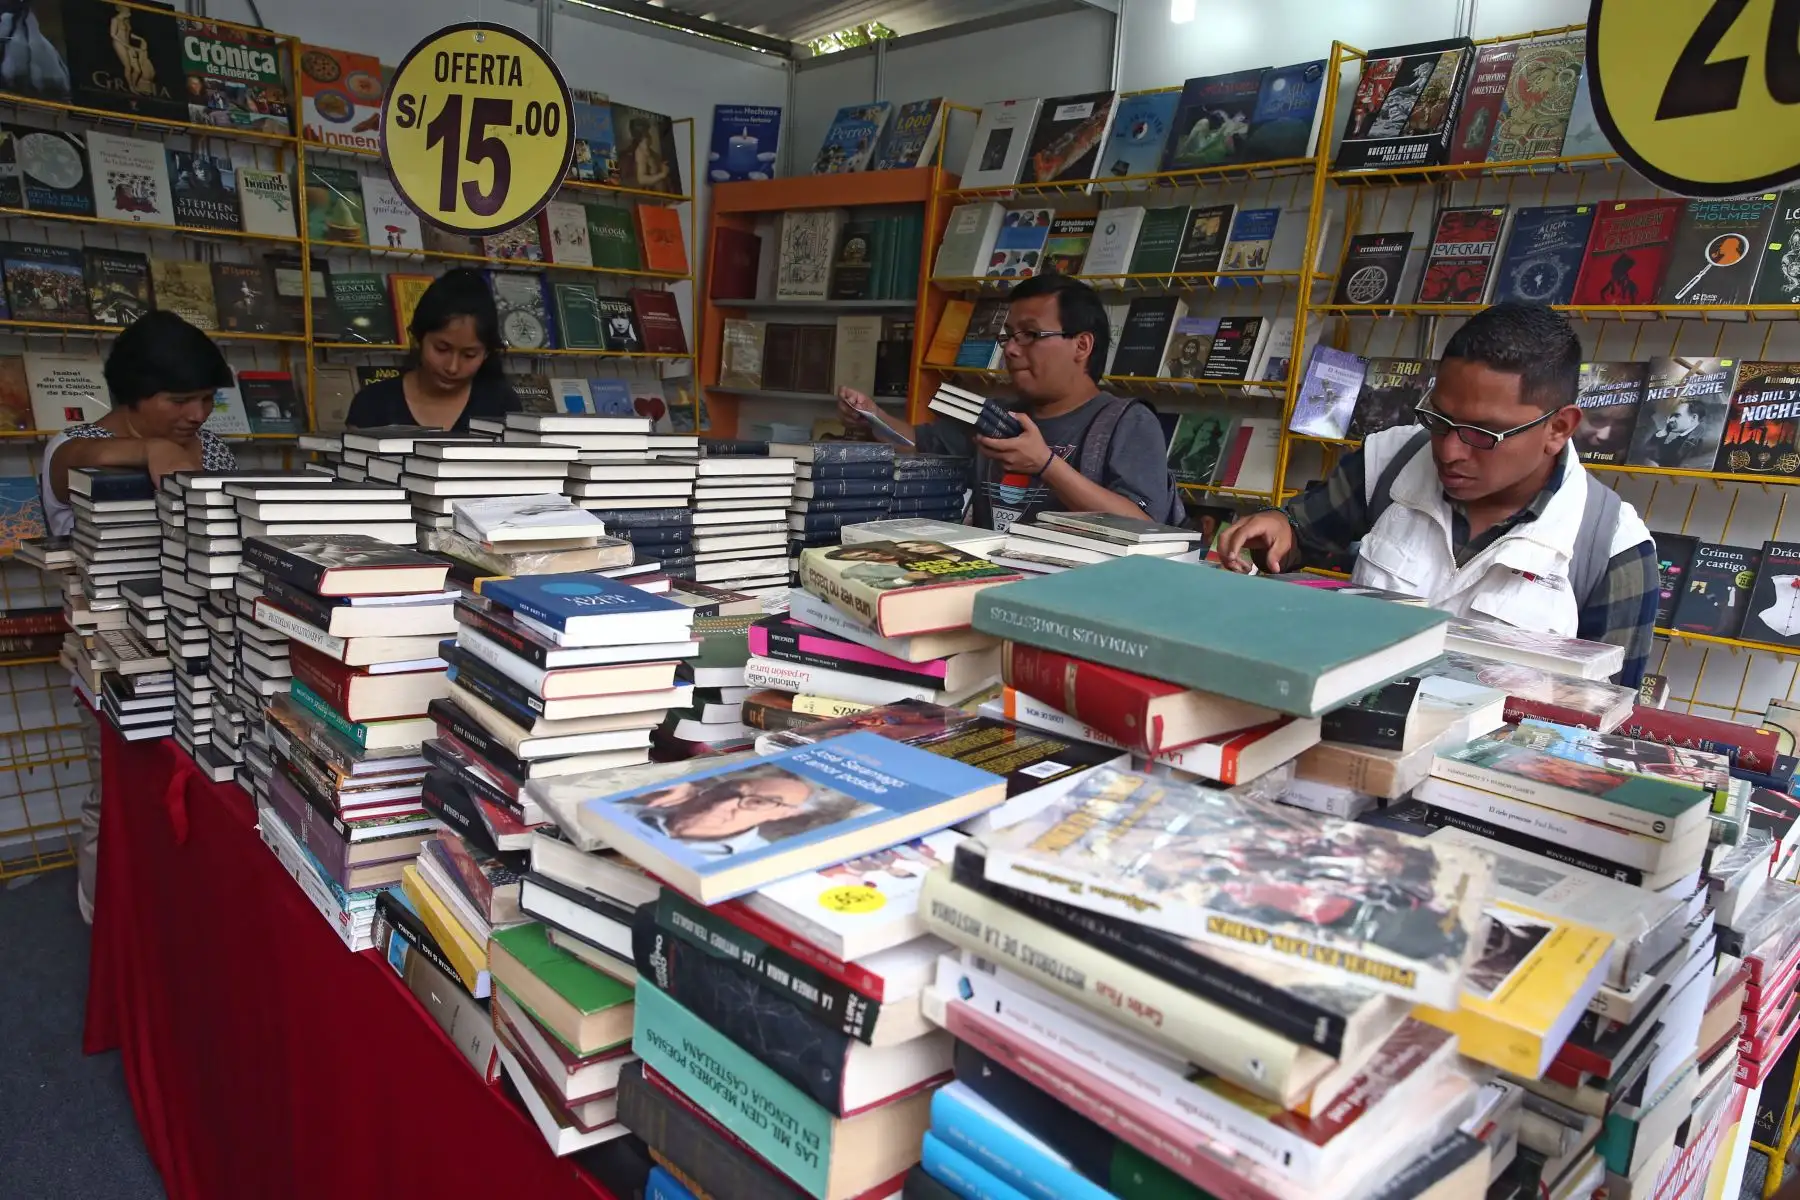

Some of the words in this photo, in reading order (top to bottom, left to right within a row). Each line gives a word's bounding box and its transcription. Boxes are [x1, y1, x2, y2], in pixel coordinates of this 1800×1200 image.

[184, 36, 276, 75] Crónica
[207, 64, 219, 76] de
[220, 67, 259, 82] América
[435, 51, 523, 86] OFERTA
[92, 70, 172, 99] GRIA
[830, 124, 873, 142] Perros
[1367, 146, 1397, 156] NUESTRA
[1399, 143, 1429, 154] MEMORIA
[244, 177, 288, 191] hombre
[179, 198, 233, 212] STEPHEN
[1688, 202, 1773, 212] SHERLOCK
[1723, 194, 1763, 202] COMPLETA
[177, 207, 239, 222] HAWKING
[1695, 212, 1761, 221] HOLMES
[1537, 221, 1567, 236] ALICIA
[1433, 242, 1493, 257] LOVECRAFT
[600, 302, 633, 313] brujas
[1646, 381, 1724, 402] NIETZSCHE
[1737, 394, 1759, 405] Las
[1593, 452, 1614, 461] Freud
[1700, 547, 1744, 560] Crimen
[1695, 558, 1701, 568] y
[1706, 560, 1747, 573] castigo
[838, 586, 855, 608] vez
[854, 594, 871, 617] una
[990, 607, 1071, 640] DOMÉSTICOS
[1072, 626, 1148, 658] ANIMALES
[749, 673, 768, 685] Gala
[768, 677, 801, 690] Antonio
[772, 667, 799, 682] pasión
[801, 672, 812, 683] La
[931, 899, 982, 938] HISTORIA
[984, 925, 999, 948] LA
[1004, 934, 1018, 957] DE
[741, 952, 755, 968] LAS
[1315, 945, 1340, 967] EN
[1021, 943, 1086, 991] HISTORIAS
[1344, 953, 1416, 990] PODER
[791, 977, 820, 1006] VIRGEN
[821, 993, 834, 1011] LA
[1127, 1002, 1165, 1028] Carlos
[646, 1027, 689, 1071] POESIAS
[682, 1036, 748, 1096] CASTELLANA
[690, 1064, 740, 1109] MEJORES
[743, 1101, 769, 1131] CIEN
[751, 1087, 799, 1135] LENGUA
[770, 1124, 793, 1152] MIL
[801, 1126, 821, 1152] EN
[794, 1140, 820, 1170] LAS
